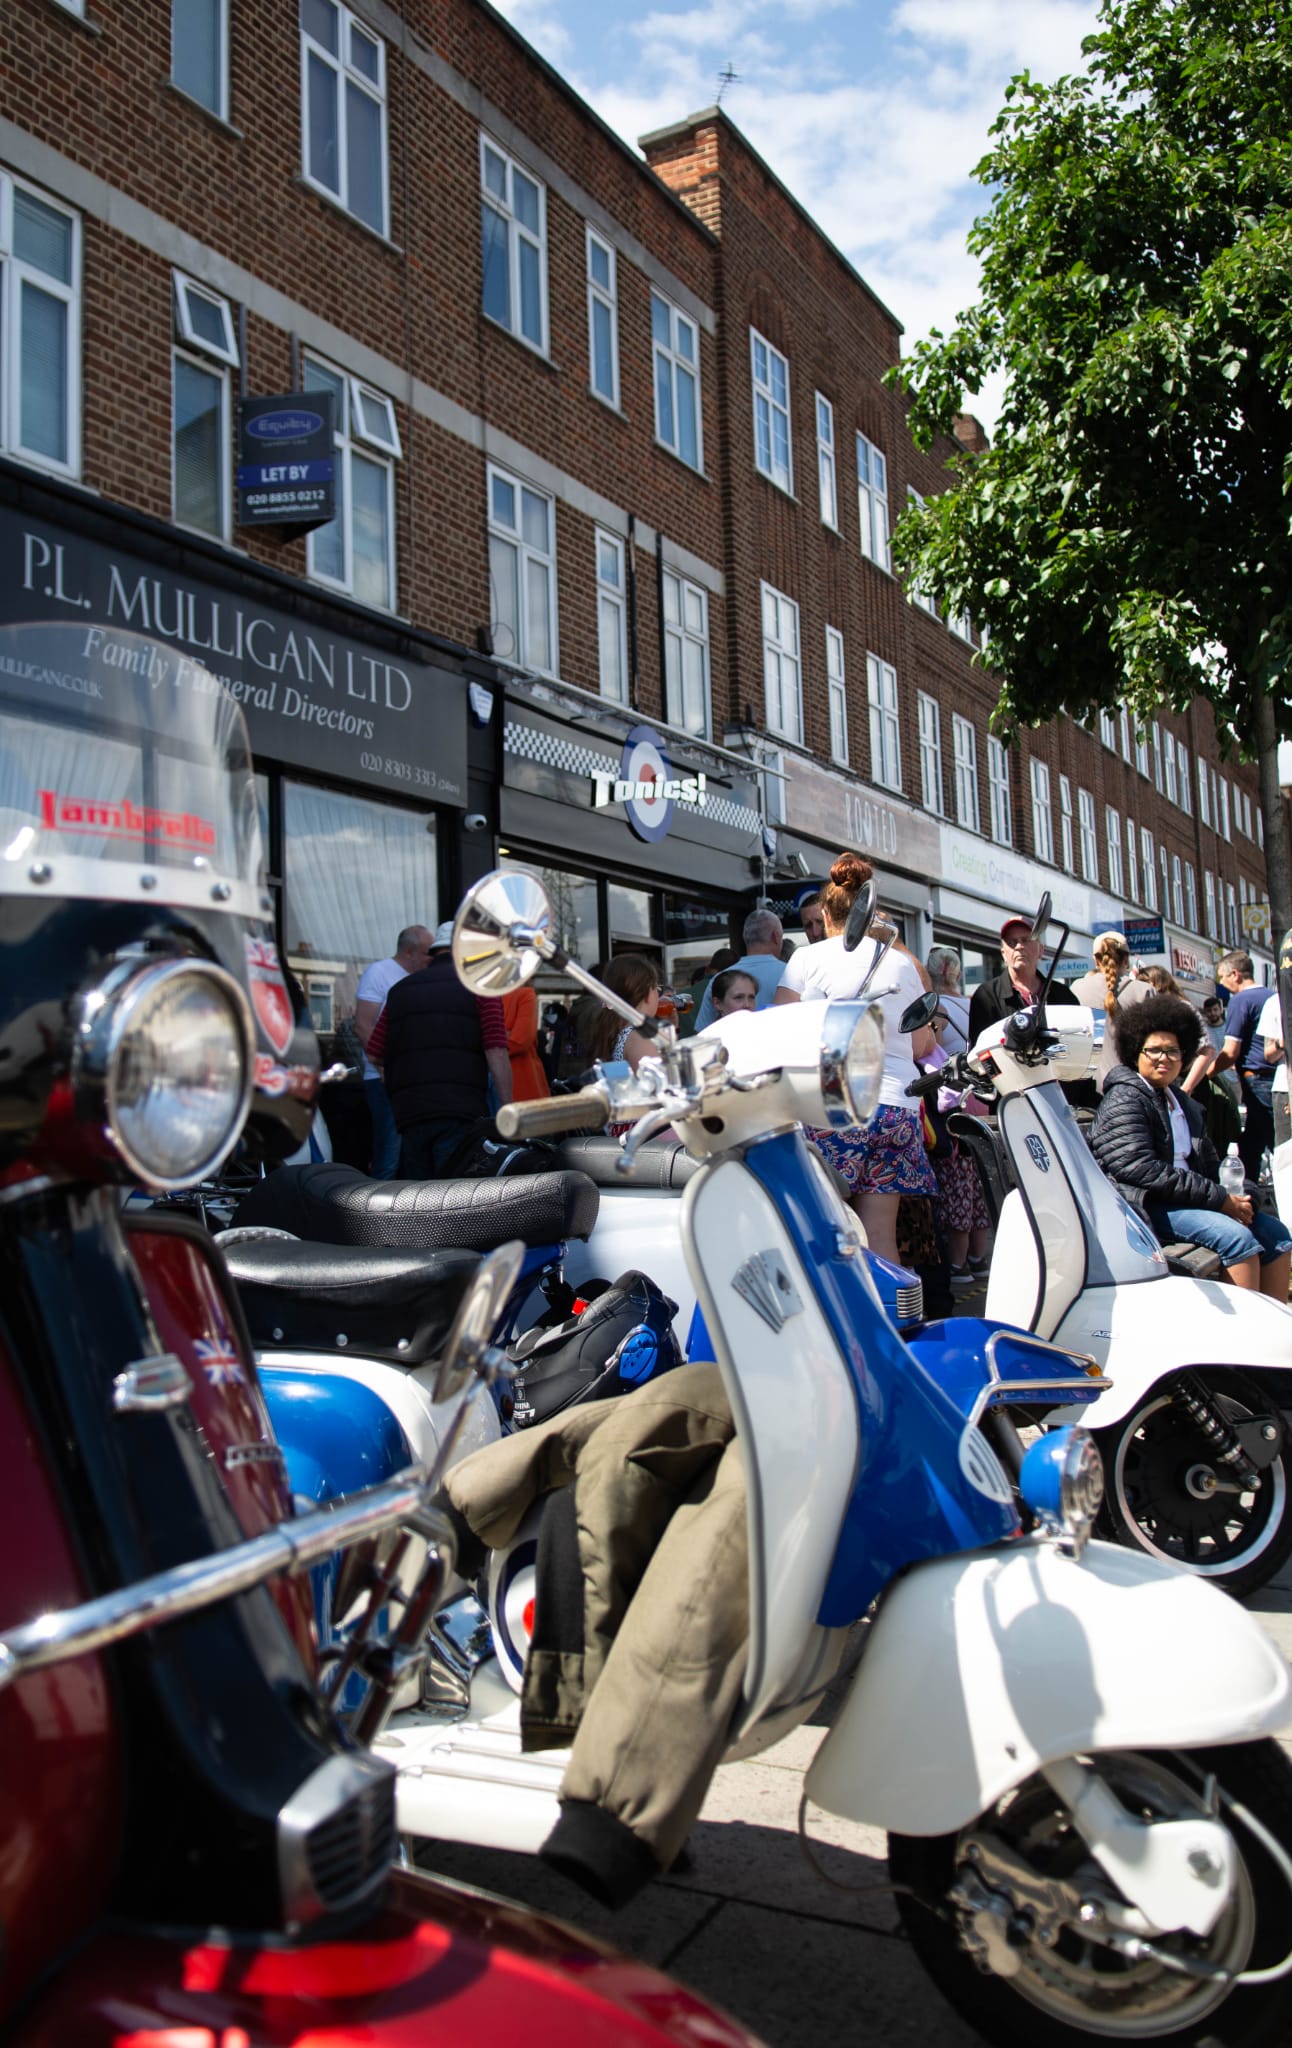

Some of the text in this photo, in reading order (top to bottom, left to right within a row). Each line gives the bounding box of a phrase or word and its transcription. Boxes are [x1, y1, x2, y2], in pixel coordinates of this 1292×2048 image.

[261, 465, 310, 483] LET BY
[247, 495, 267, 505] 020
[298, 490, 325, 501] 0212
[22, 532, 412, 711] P.L. MULLIGAN LTD
[82, 626, 169, 689] Family
[282, 687, 375, 740] Directors
[360, 752, 383, 772] 020
[384, 759, 412, 781] 8303
[415, 767, 437, 787] 3313
[591, 770, 707, 808] Tonics!
[845, 793, 897, 856] ROOTED
[952, 846, 988, 884] Creating
[1124, 919, 1160, 929] TESCO
